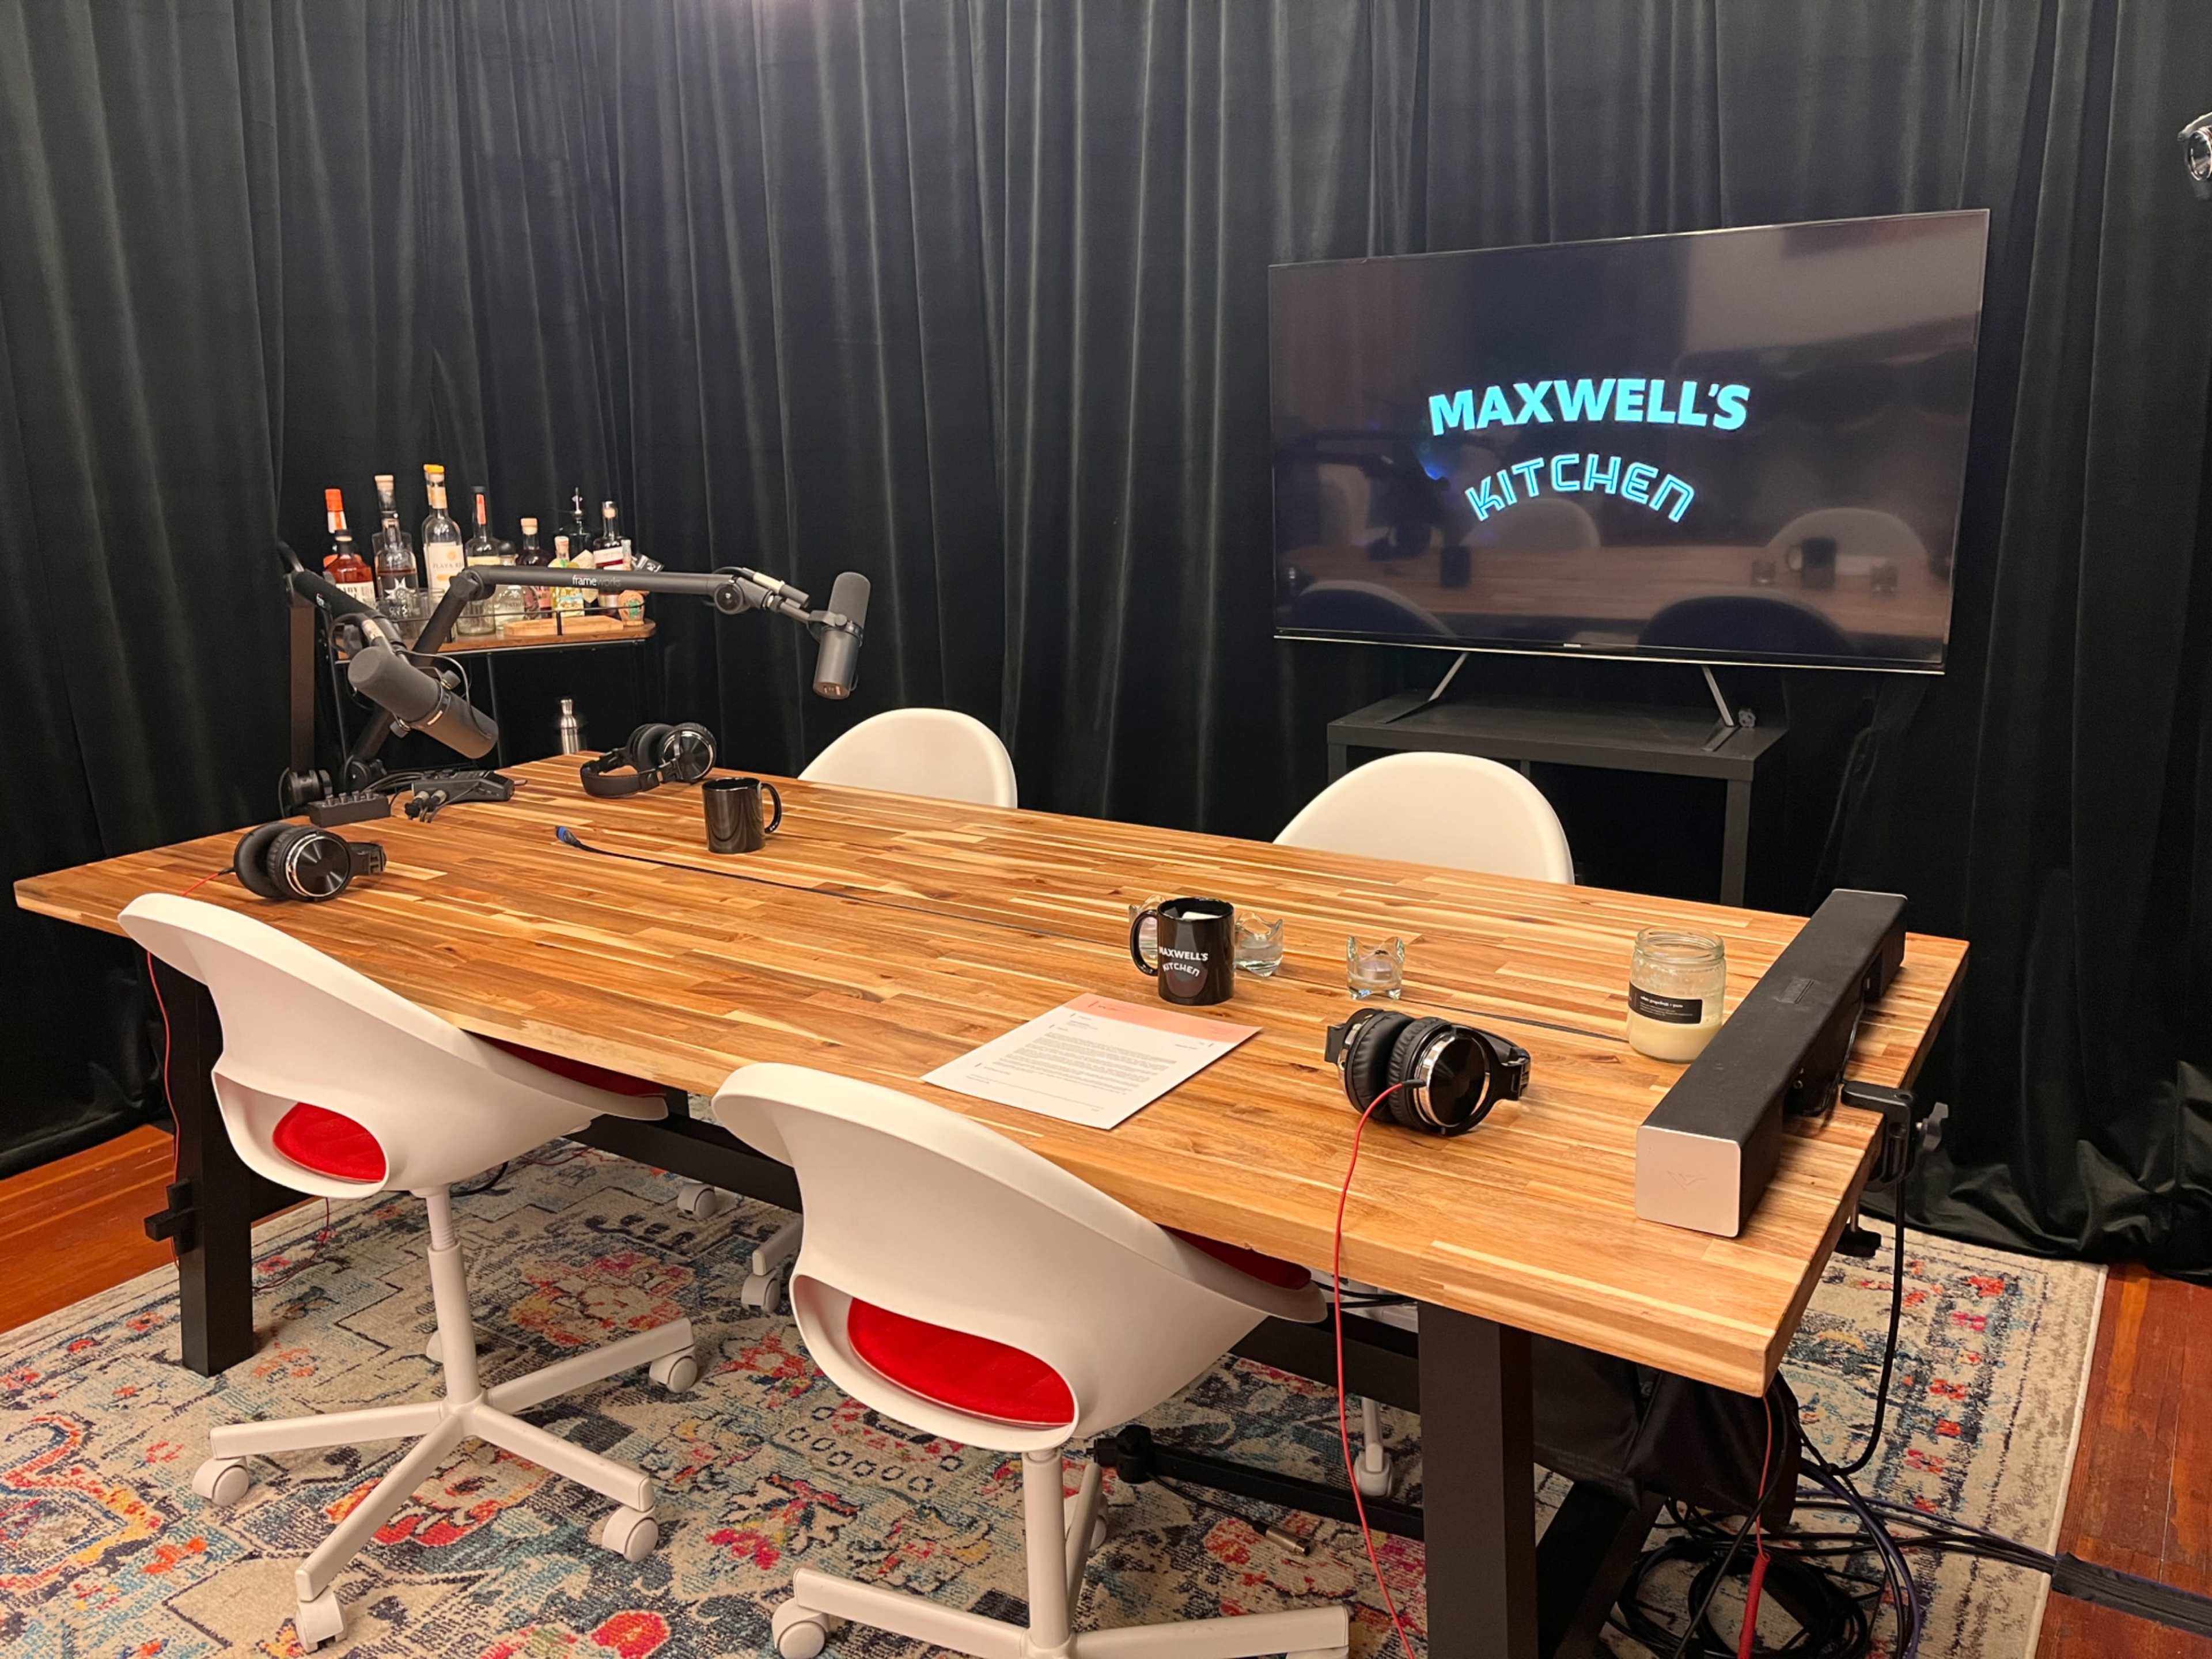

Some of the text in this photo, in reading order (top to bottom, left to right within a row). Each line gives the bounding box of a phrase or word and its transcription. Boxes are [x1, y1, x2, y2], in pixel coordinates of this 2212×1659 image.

[1429, 378, 1750, 435] MAXWELL'S
[1464, 453, 1695, 522] KITCHEN
[1158, 946, 1209, 962] MAXWELL'S
[1162, 963, 1200, 978] KITCHEN
